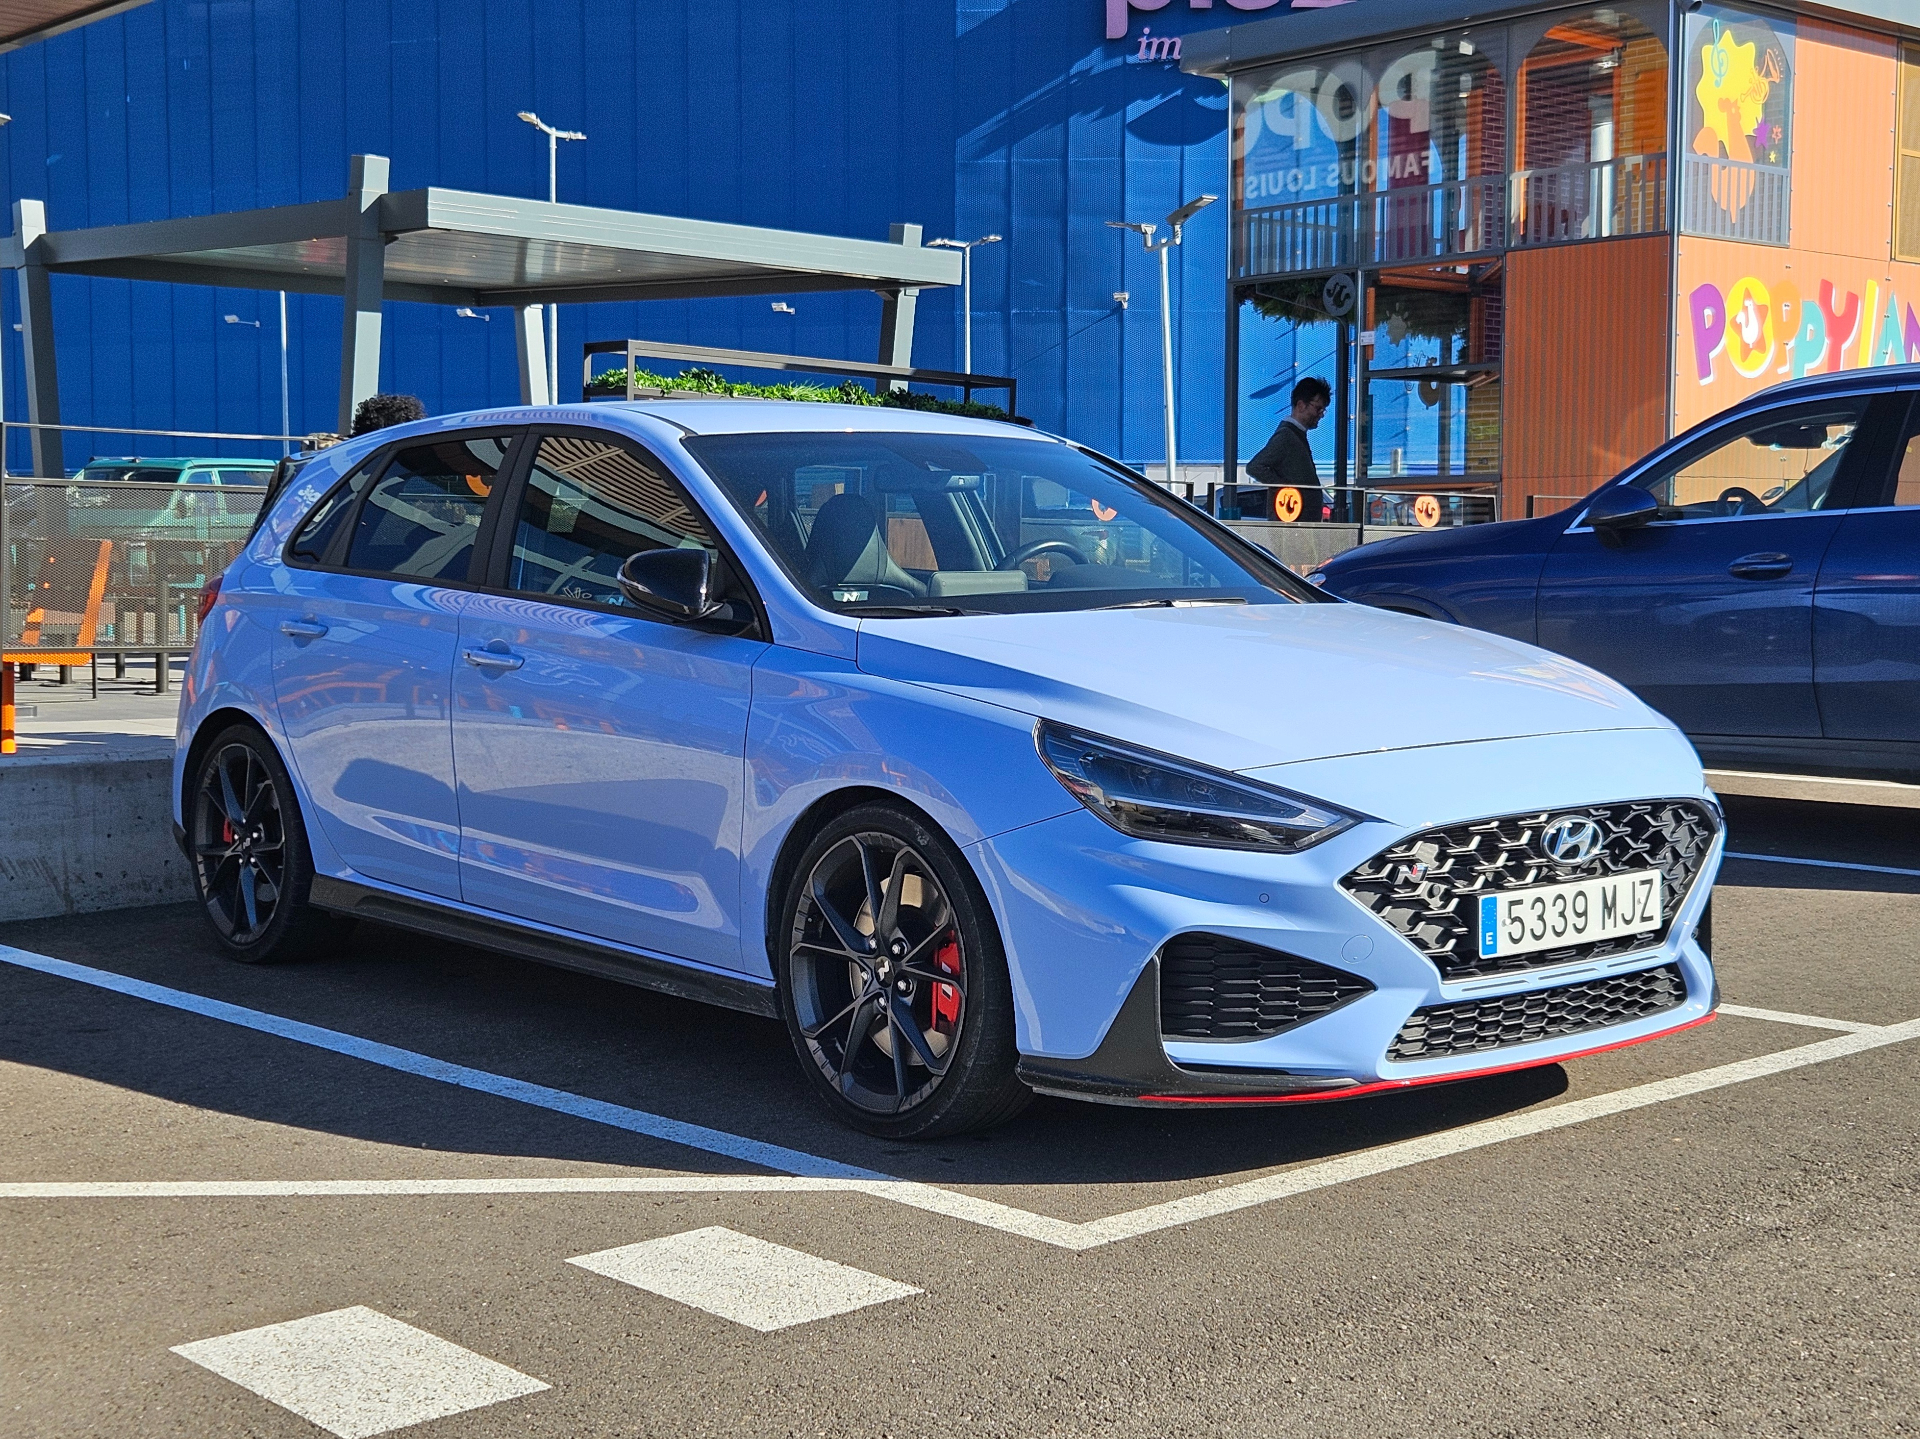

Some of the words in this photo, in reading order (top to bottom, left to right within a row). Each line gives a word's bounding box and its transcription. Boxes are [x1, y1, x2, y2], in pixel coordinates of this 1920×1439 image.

[1506, 890, 1589, 945] 5339
[1601, 878, 1655, 931] MJZ
[1485, 932, 1494, 945] E
